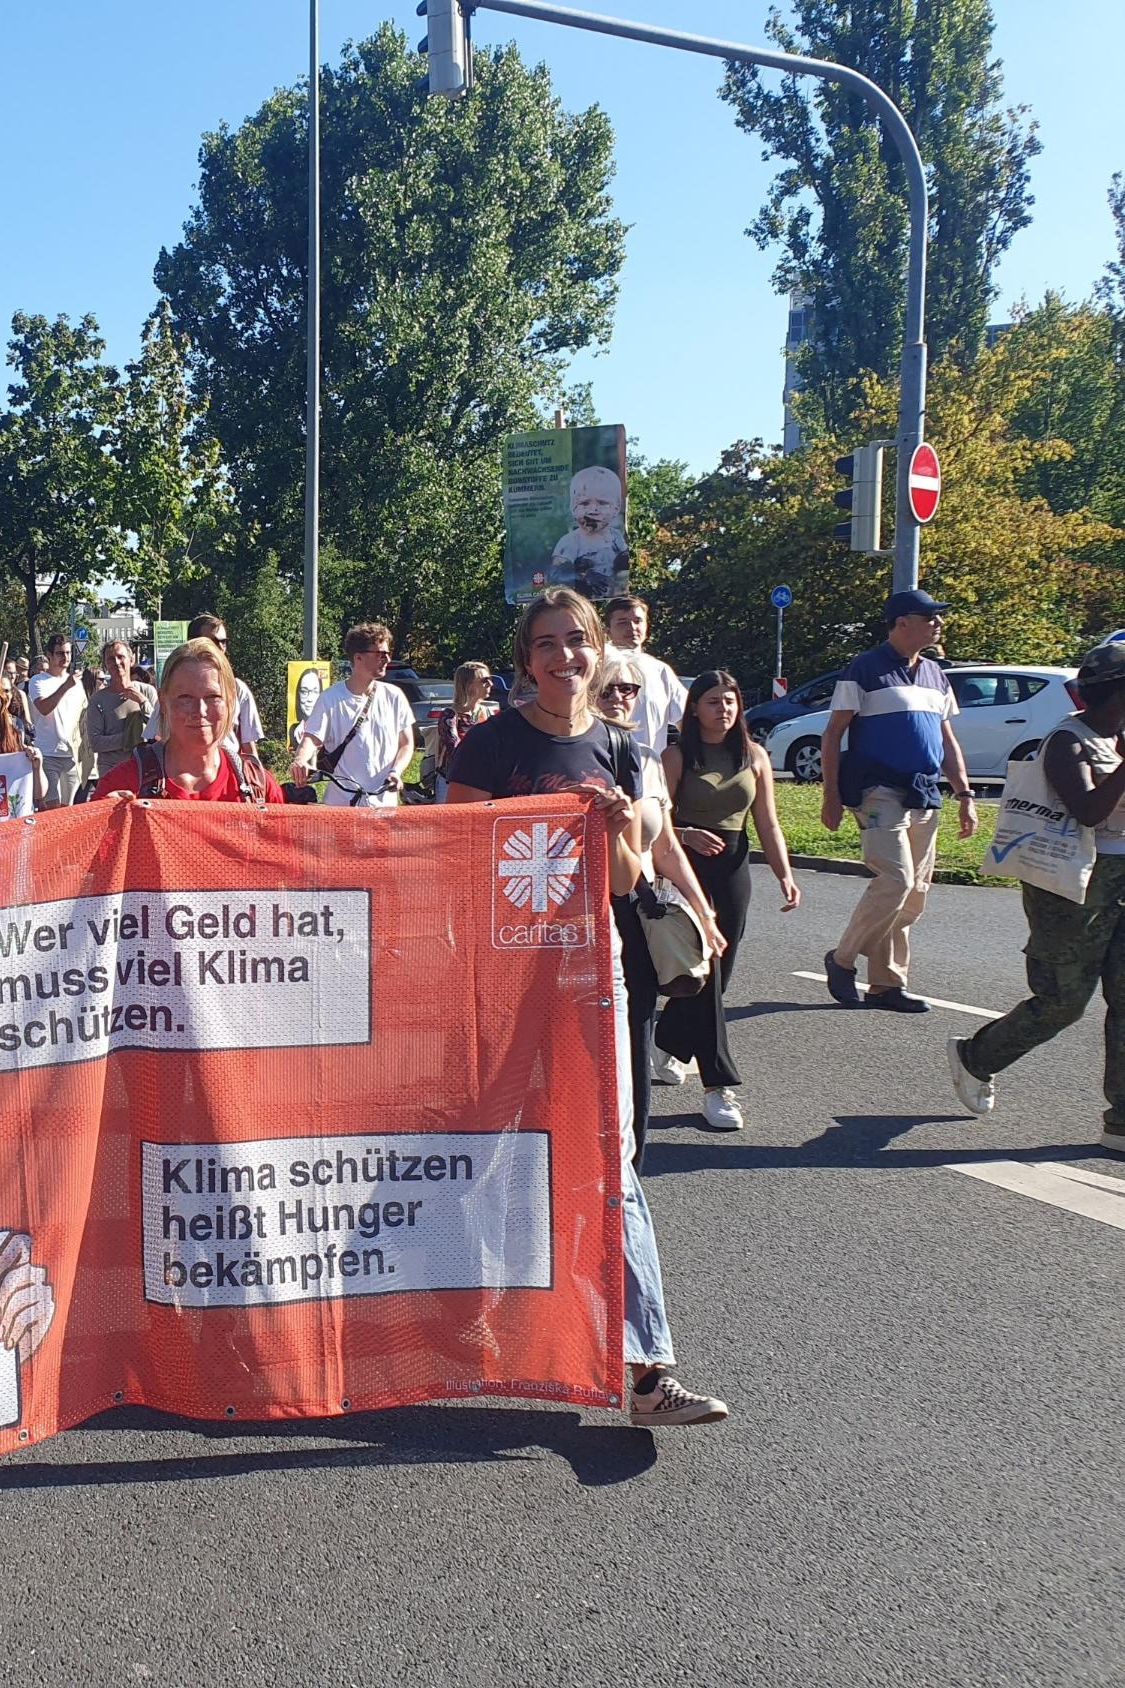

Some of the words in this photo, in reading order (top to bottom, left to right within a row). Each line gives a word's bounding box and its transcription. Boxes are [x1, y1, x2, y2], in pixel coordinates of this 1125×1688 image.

[86, 904, 150, 946] viel
[165, 904, 258, 941] Geld
[272, 904, 345, 943] hat,
[499, 919, 578, 944] caritas
[116, 949, 183, 987] viel
[198, 949, 310, 986] Klima
[162, 1157, 277, 1194] Klima
[289, 1148, 473, 1188] schützen
[162, 1204, 267, 1241] heißt
[279, 1199, 423, 1238] Hunger
[163, 1243, 396, 1290] bekämpfen.
[446, 1378, 507, 1391] Illustation:
[511, 1380, 570, 1395] Franziska
